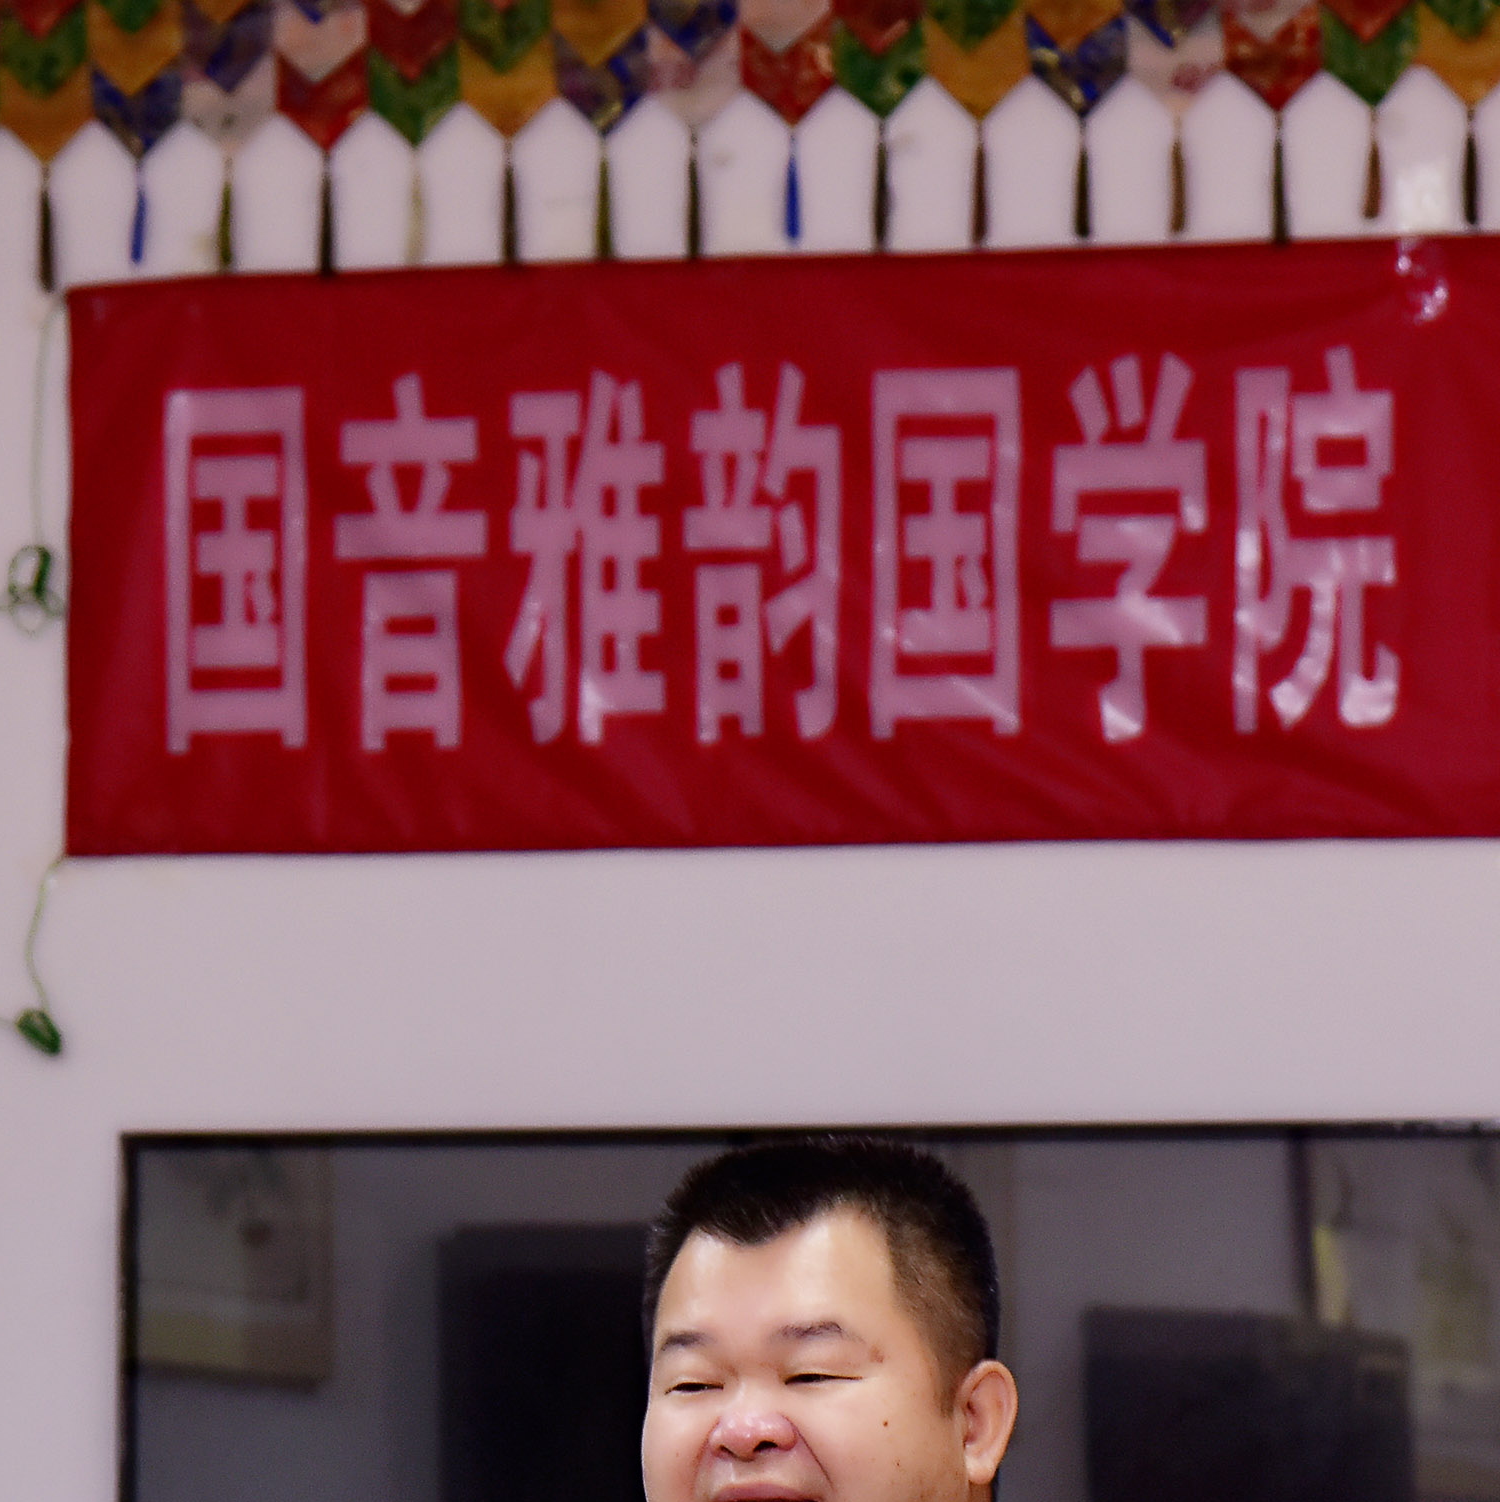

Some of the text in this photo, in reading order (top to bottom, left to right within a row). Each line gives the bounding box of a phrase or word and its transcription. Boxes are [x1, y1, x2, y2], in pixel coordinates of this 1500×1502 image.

[163, 346, 1400, 754] 国音雅韵国学院
